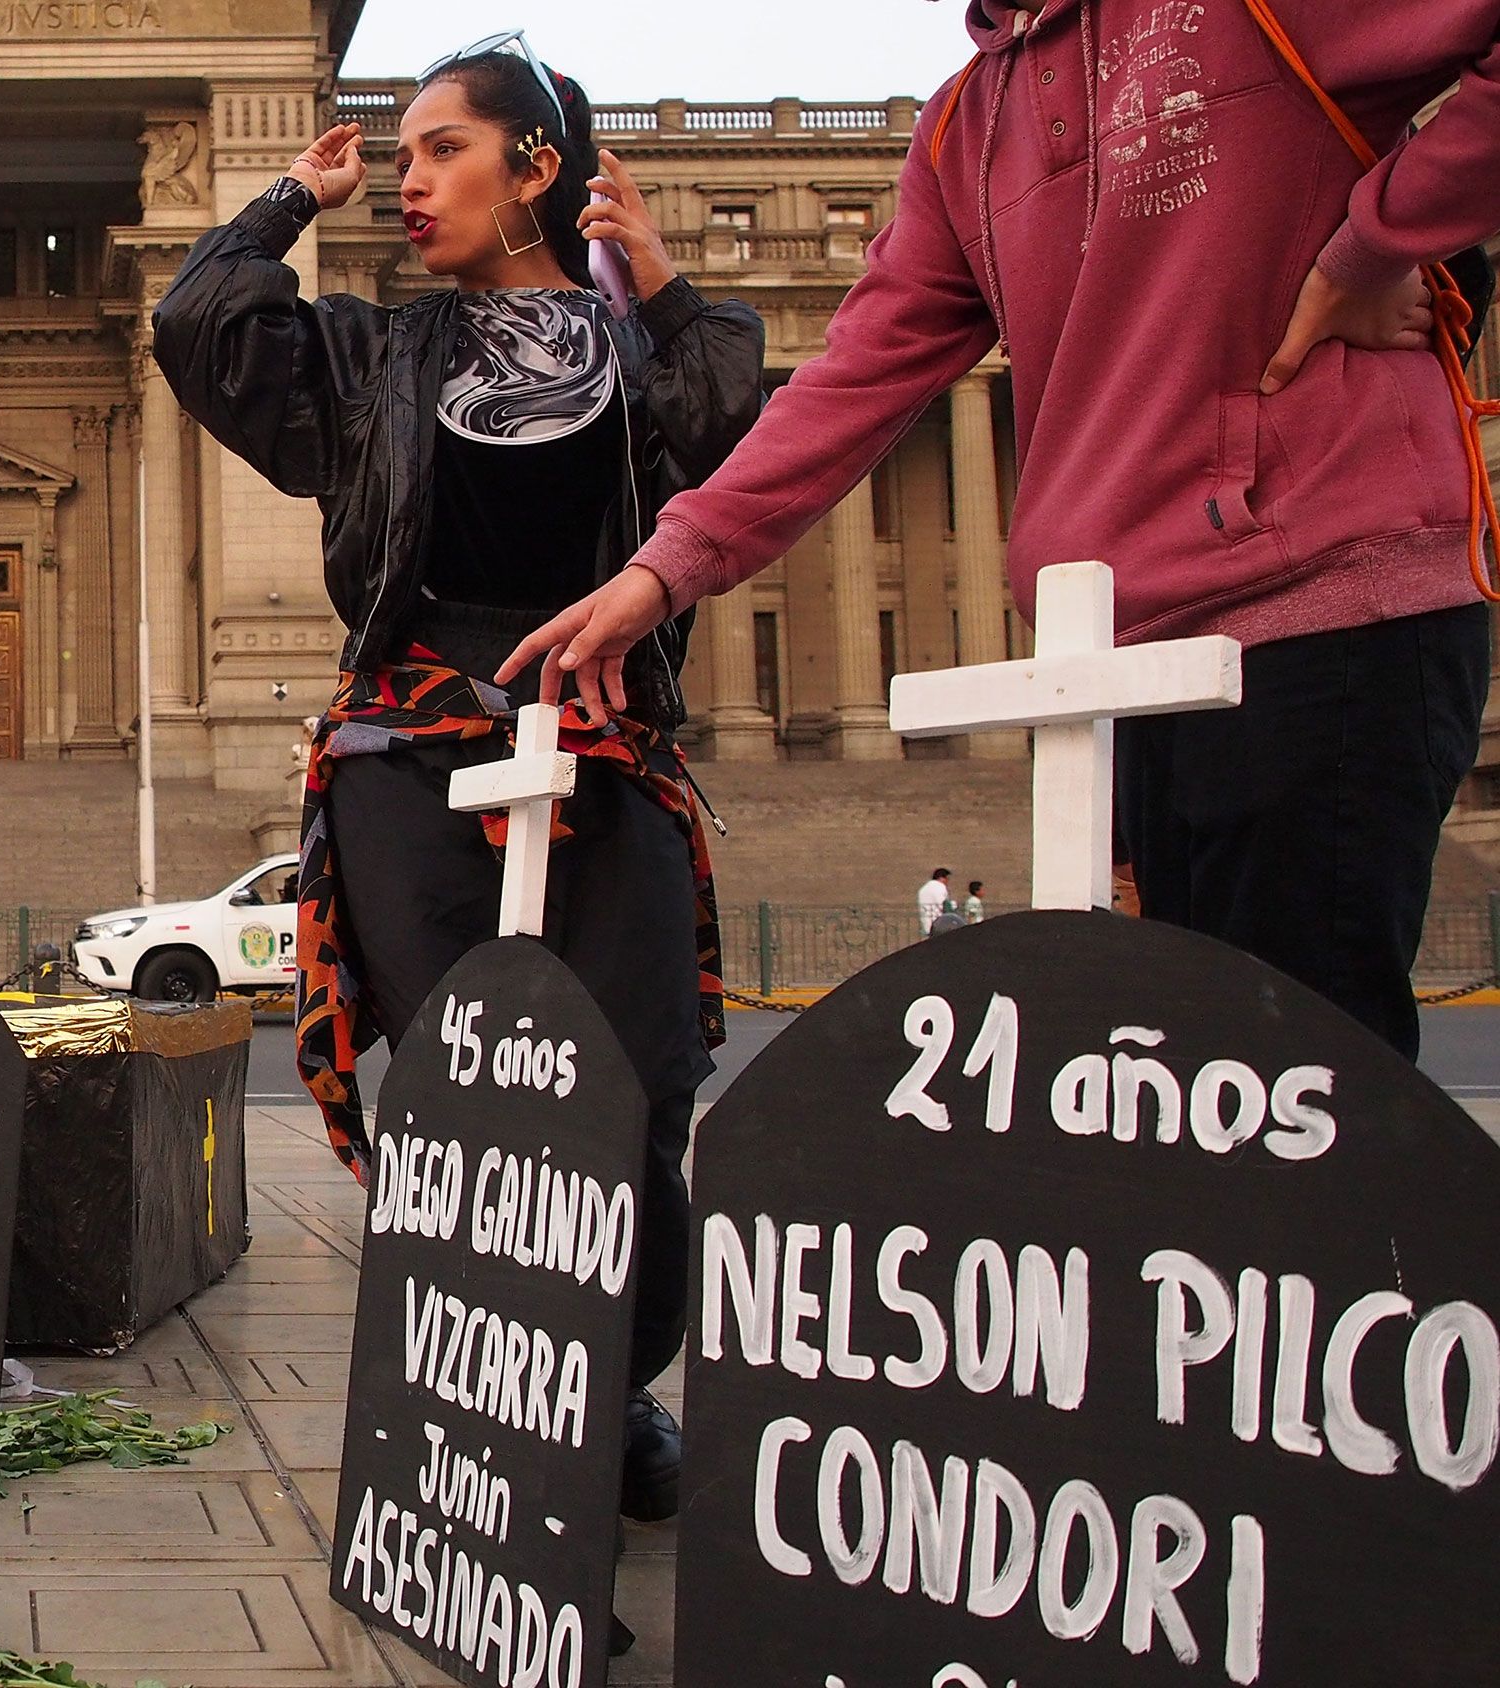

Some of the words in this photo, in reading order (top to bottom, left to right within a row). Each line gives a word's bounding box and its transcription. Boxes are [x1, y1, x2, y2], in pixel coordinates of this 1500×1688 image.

[441, 994, 482, 1086] 45
[493, 1017, 576, 1098] años
[885, 993, 1018, 1132] 21
[1051, 1027, 1335, 1159] años
[370, 1108, 463, 1240] DIEGO
[406, 1274, 591, 1450] VIZCARRA
[702, 1213, 1089, 1410] NELSON
[1141, 1250, 1500, 1489] PILCO
[344, 1484, 582, 1688] ASESINADO
[755, 1416, 1265, 1686] CONDORI
